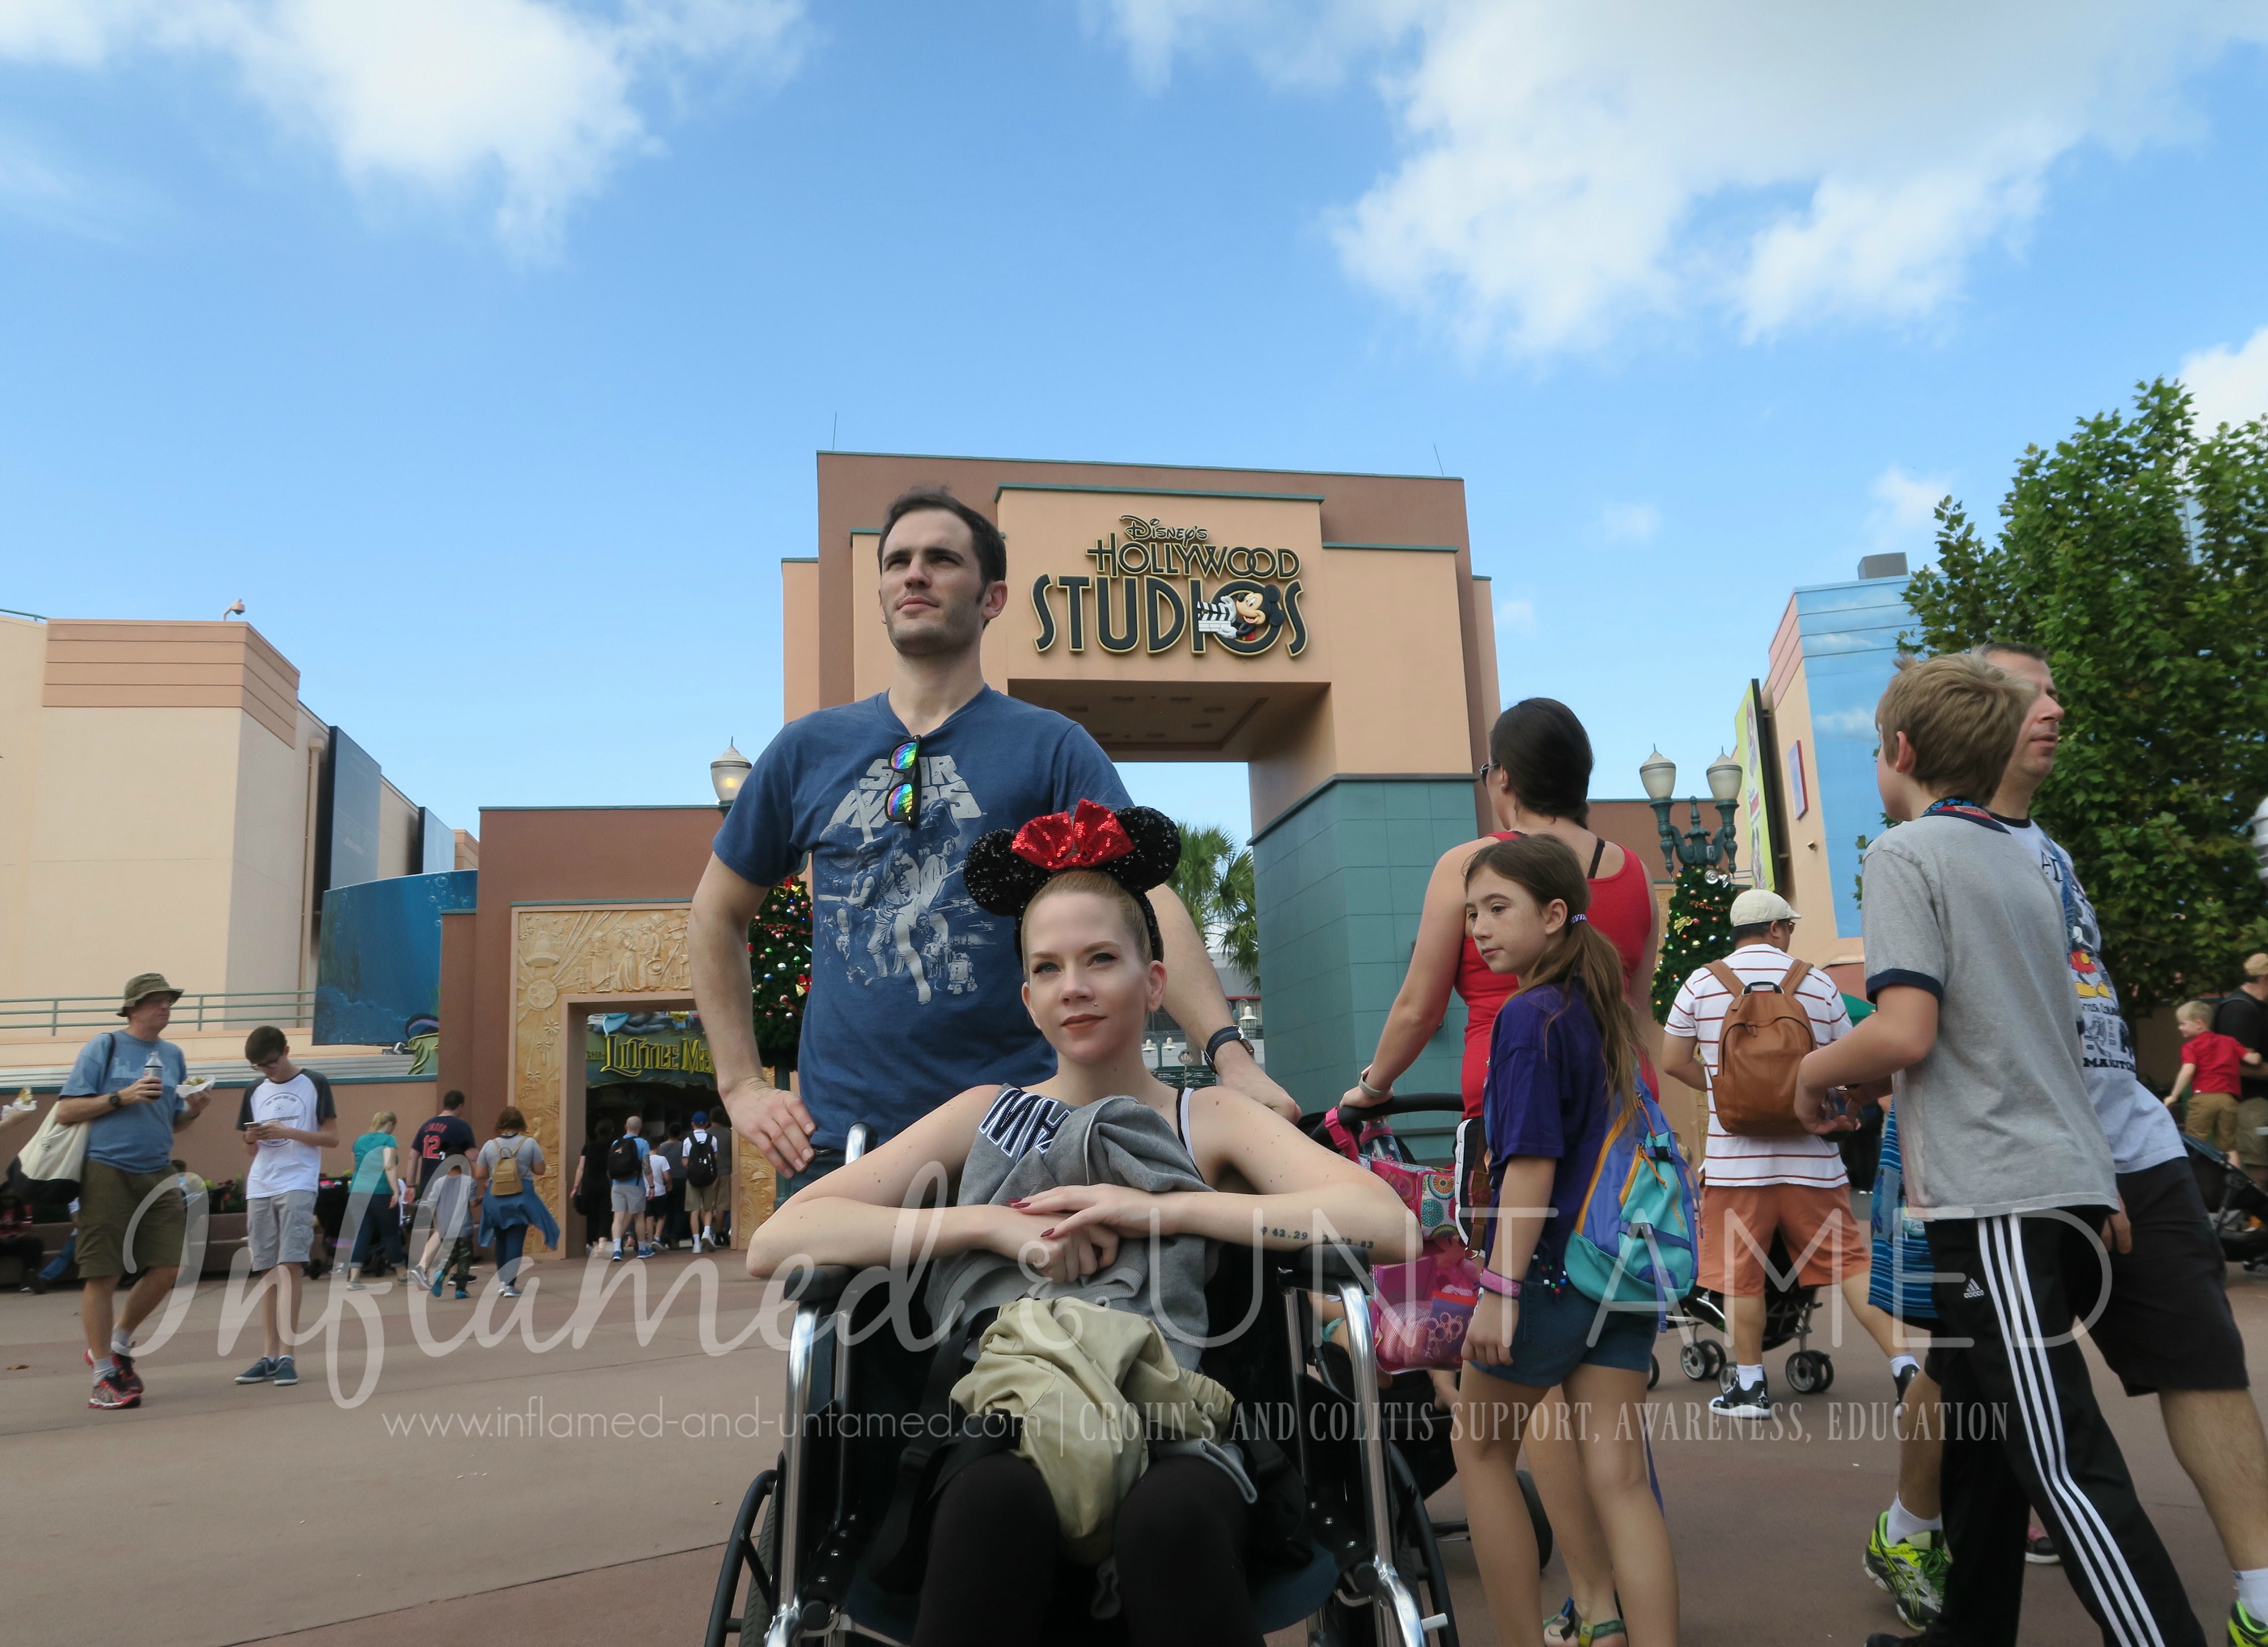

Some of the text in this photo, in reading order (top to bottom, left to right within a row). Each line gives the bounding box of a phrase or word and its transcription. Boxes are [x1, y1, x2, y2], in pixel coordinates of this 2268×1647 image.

[1085, 532, 1302, 580] HOLLYWOOD
[1030, 573, 1309, 657] STUDIOS
[600, 1035, 680, 1077] LITTLE
[423, 1134, 440, 1159] 12
[1964, 1289, 1984, 1298] adidas
